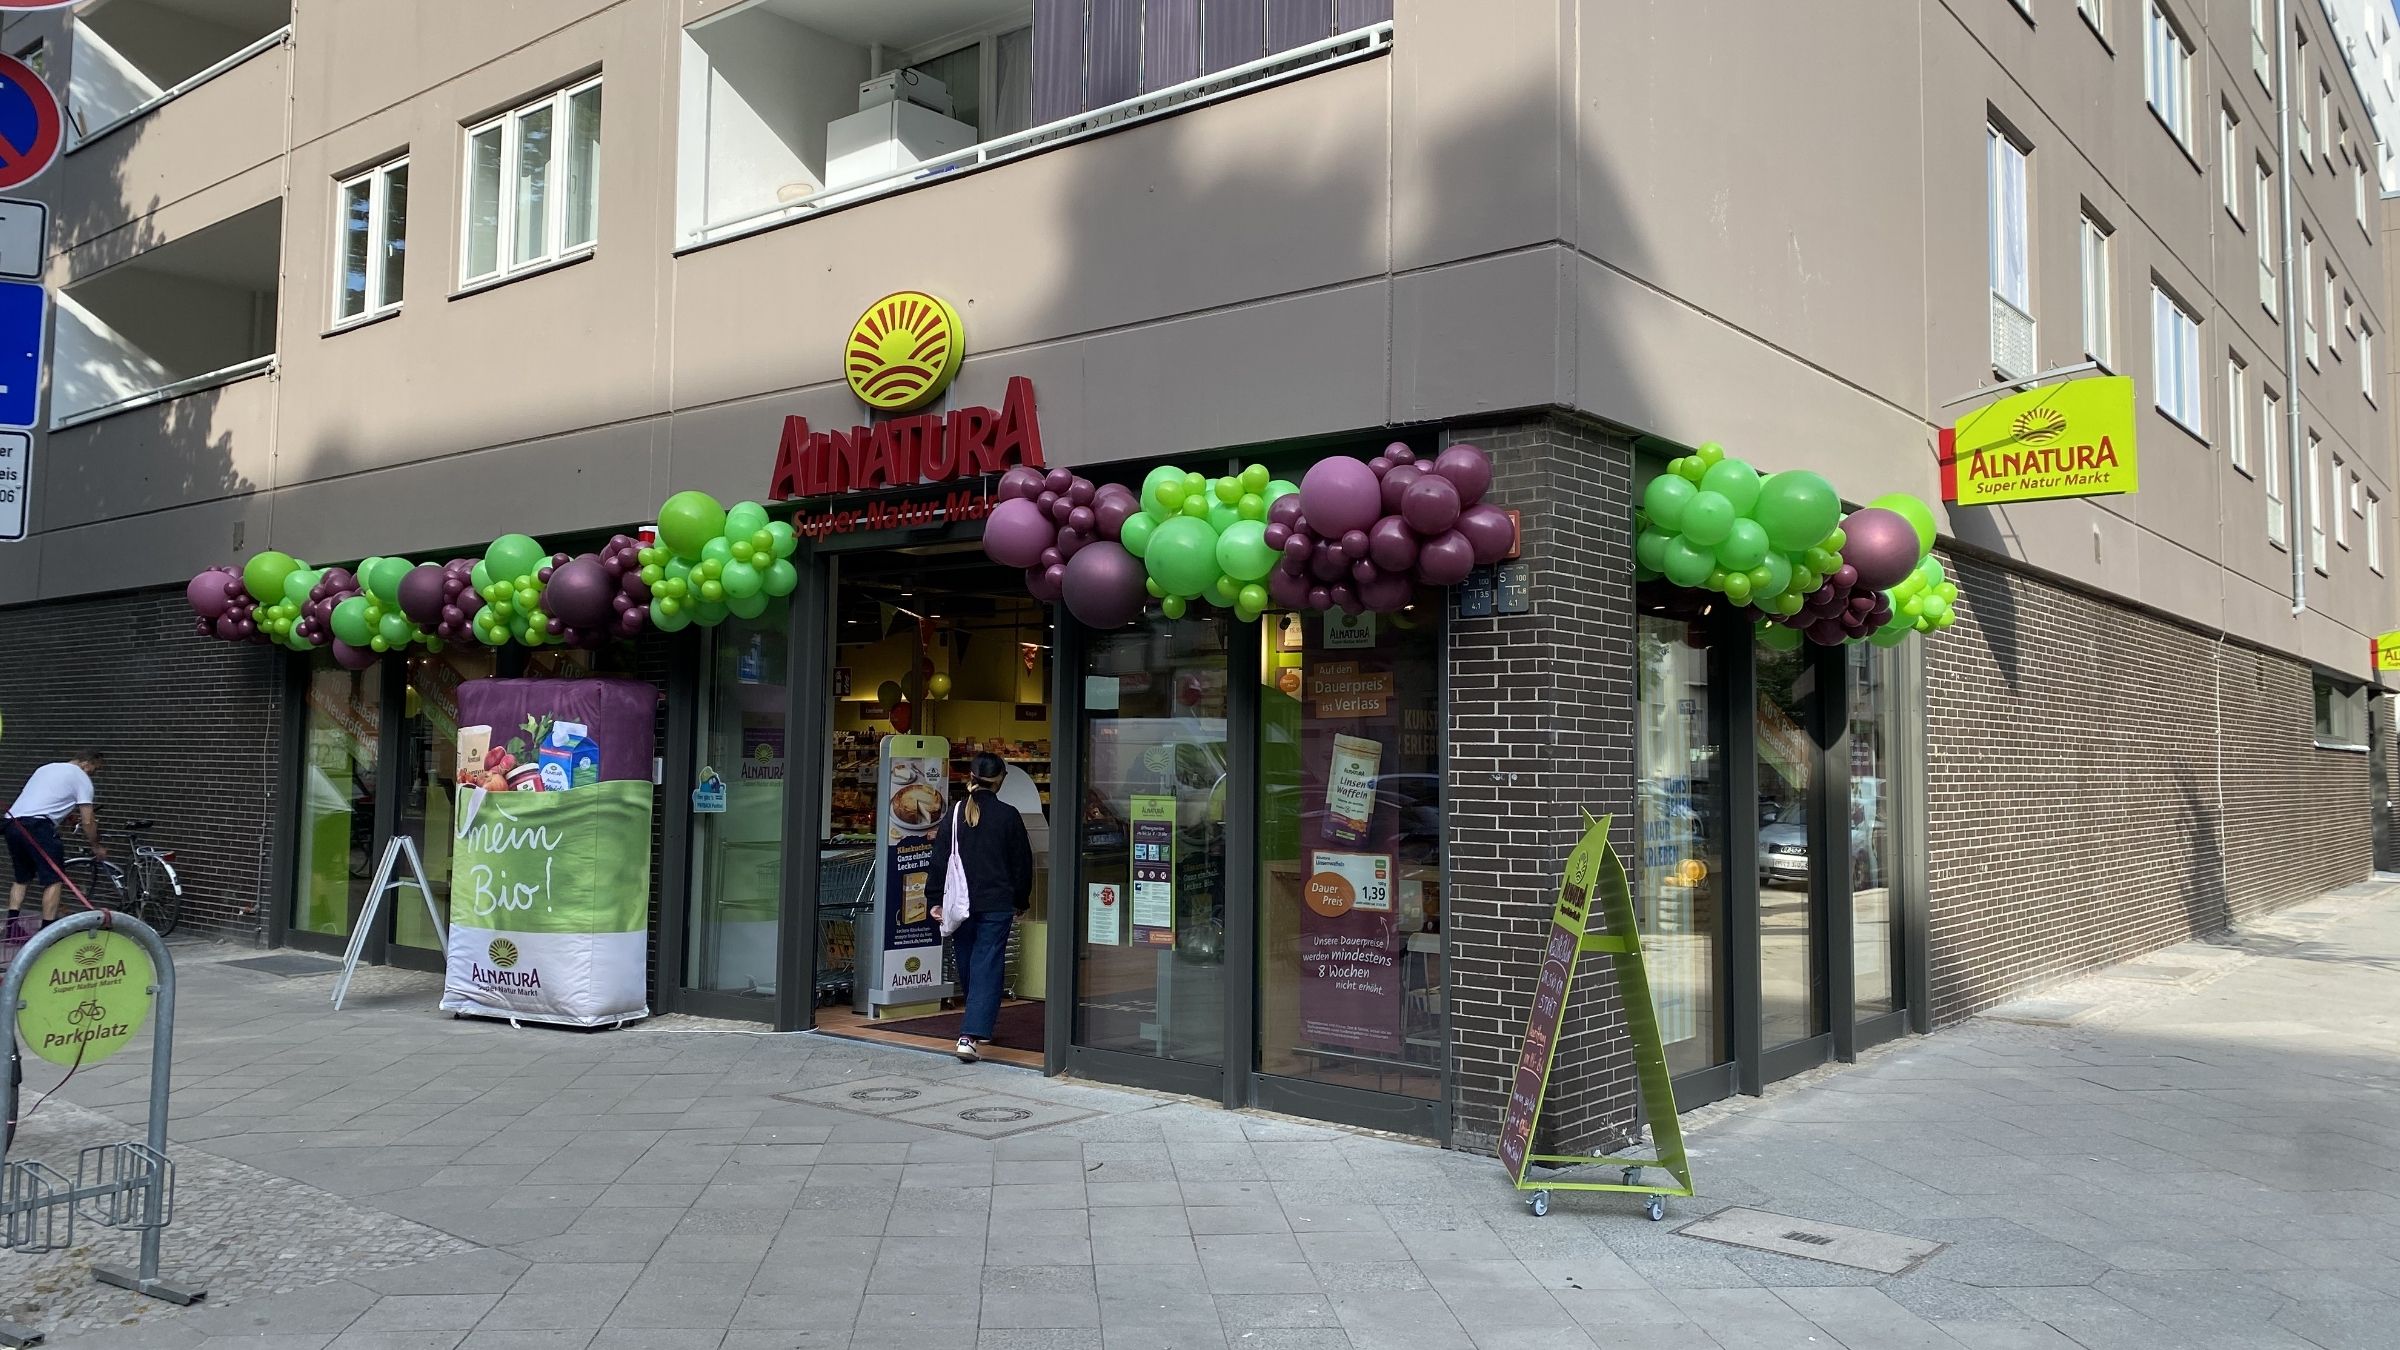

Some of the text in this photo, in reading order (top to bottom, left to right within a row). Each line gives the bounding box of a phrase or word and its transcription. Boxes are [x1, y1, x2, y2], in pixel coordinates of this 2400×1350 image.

[768, 376, 1046, 500] ALNATURA
[1968, 435, 2119, 481] ALNATURA
[1976, 471, 2110, 495] Super Natur Markt
[793, 490, 999, 543] Super Natur Mar
[1499, 572, 1507, 582] S
[1329, 626, 1370, 640] ALNATURA
[1319, 665, 1352, 675] Auf den
[1322, 697, 1380, 711] ist Verlass
[1340, 776, 1366, 789] Linsen
[1336, 786, 1368, 799] Waffeln
[470, 856, 554, 916] Bio!
[1311, 882, 1339, 894] Dauer
[1362, 886, 1386, 901] 1,39
[1322, 895, 1343, 907] Preis
[1313, 935, 1384, 949] Unsere Dauerpreise
[1303, 948, 1393, 967] werden mindestens
[49, 959, 126, 986] ALNATURA
[472, 962, 541, 988] ALNATURA
[892, 969, 932, 987] ALNATURA
[1318, 963, 1370, 978] 8 Wochen
[498, 985, 517, 995] Natur
[518, 987, 538, 997] Markt
[1335, 979, 1384, 996] nicht erhöht.
[43, 1023, 129, 1049] Parkplatz
